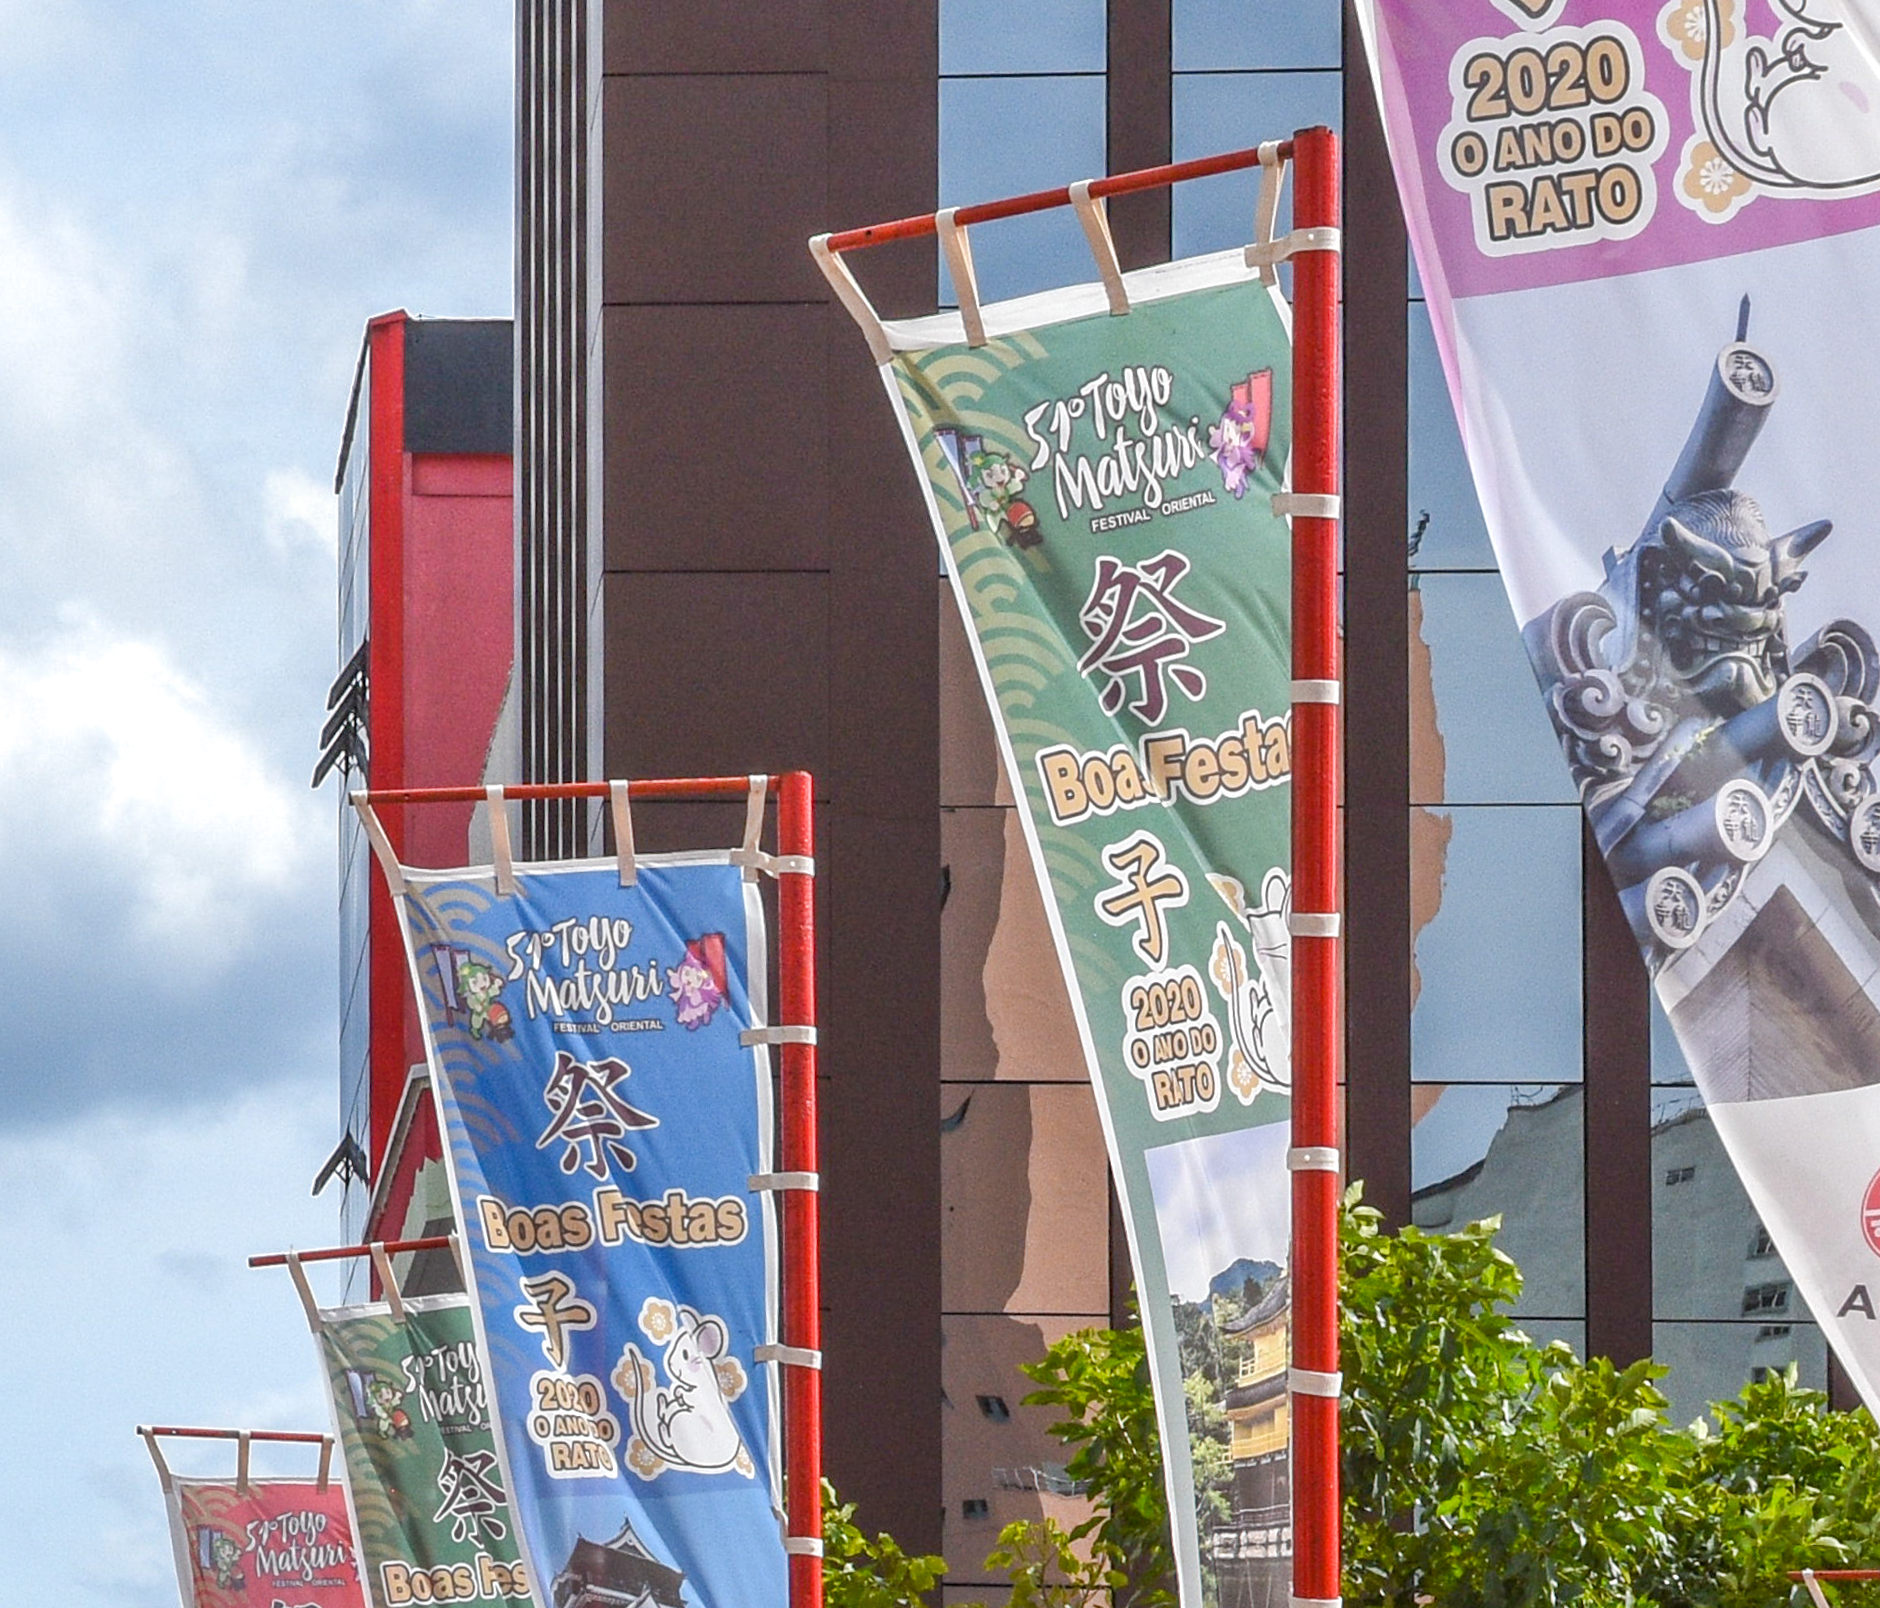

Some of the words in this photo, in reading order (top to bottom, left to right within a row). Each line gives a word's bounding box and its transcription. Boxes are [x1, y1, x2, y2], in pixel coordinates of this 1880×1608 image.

[1465, 36, 1630, 121] 2020
[1453, 131, 1488, 177] O
[1494, 117, 1585, 172] ANO
[1592, 106, 1655, 157] DO
[1485, 163, 1642, 241] RATO
[1081, 366, 1173, 437] Toyo
[1054, 417, 1206, 520] Matsuri
[1091, 508, 1151, 533] FESTIVAL
[1162, 491, 1216, 517] ORIENTAL
[1077, 549, 1227, 727] 祭
[1101, 838, 1183, 964] 子
[553, 916, 633, 967] Toyo
[526, 960, 664, 1025] Matsuri
[1132, 975, 1202, 1031] 2020
[553, 1022, 600, 1034] FESTIVAL
[610, 1019, 664, 1032] ORIENTAL
[1133, 1039, 1149, 1068] O
[1191, 1024, 1217, 1054] DO
[1152, 1061, 1216, 1110] RATO
[536, 1050, 660, 1181] 祭
[479, 1197, 592, 1251] Boas
[517, 1274, 593, 1369] 子
[431, 1342, 479, 1384] Toy
[538, 1378, 600, 1414] 2020
[534, 1415, 550, 1439] O
[554, 1417, 588, 1438] ANO
[550, 1442, 613, 1471] RATO
[434, 1448, 507, 1547] 祭
[276, 1511, 327, 1544] Toyo
[256, 1541, 347, 1581] Matsuri
[271, 1579, 303, 1588] FESTIVAL
[311, 1578, 346, 1587] ORIENTAL
[382, 1562, 473, 1606] Boas
